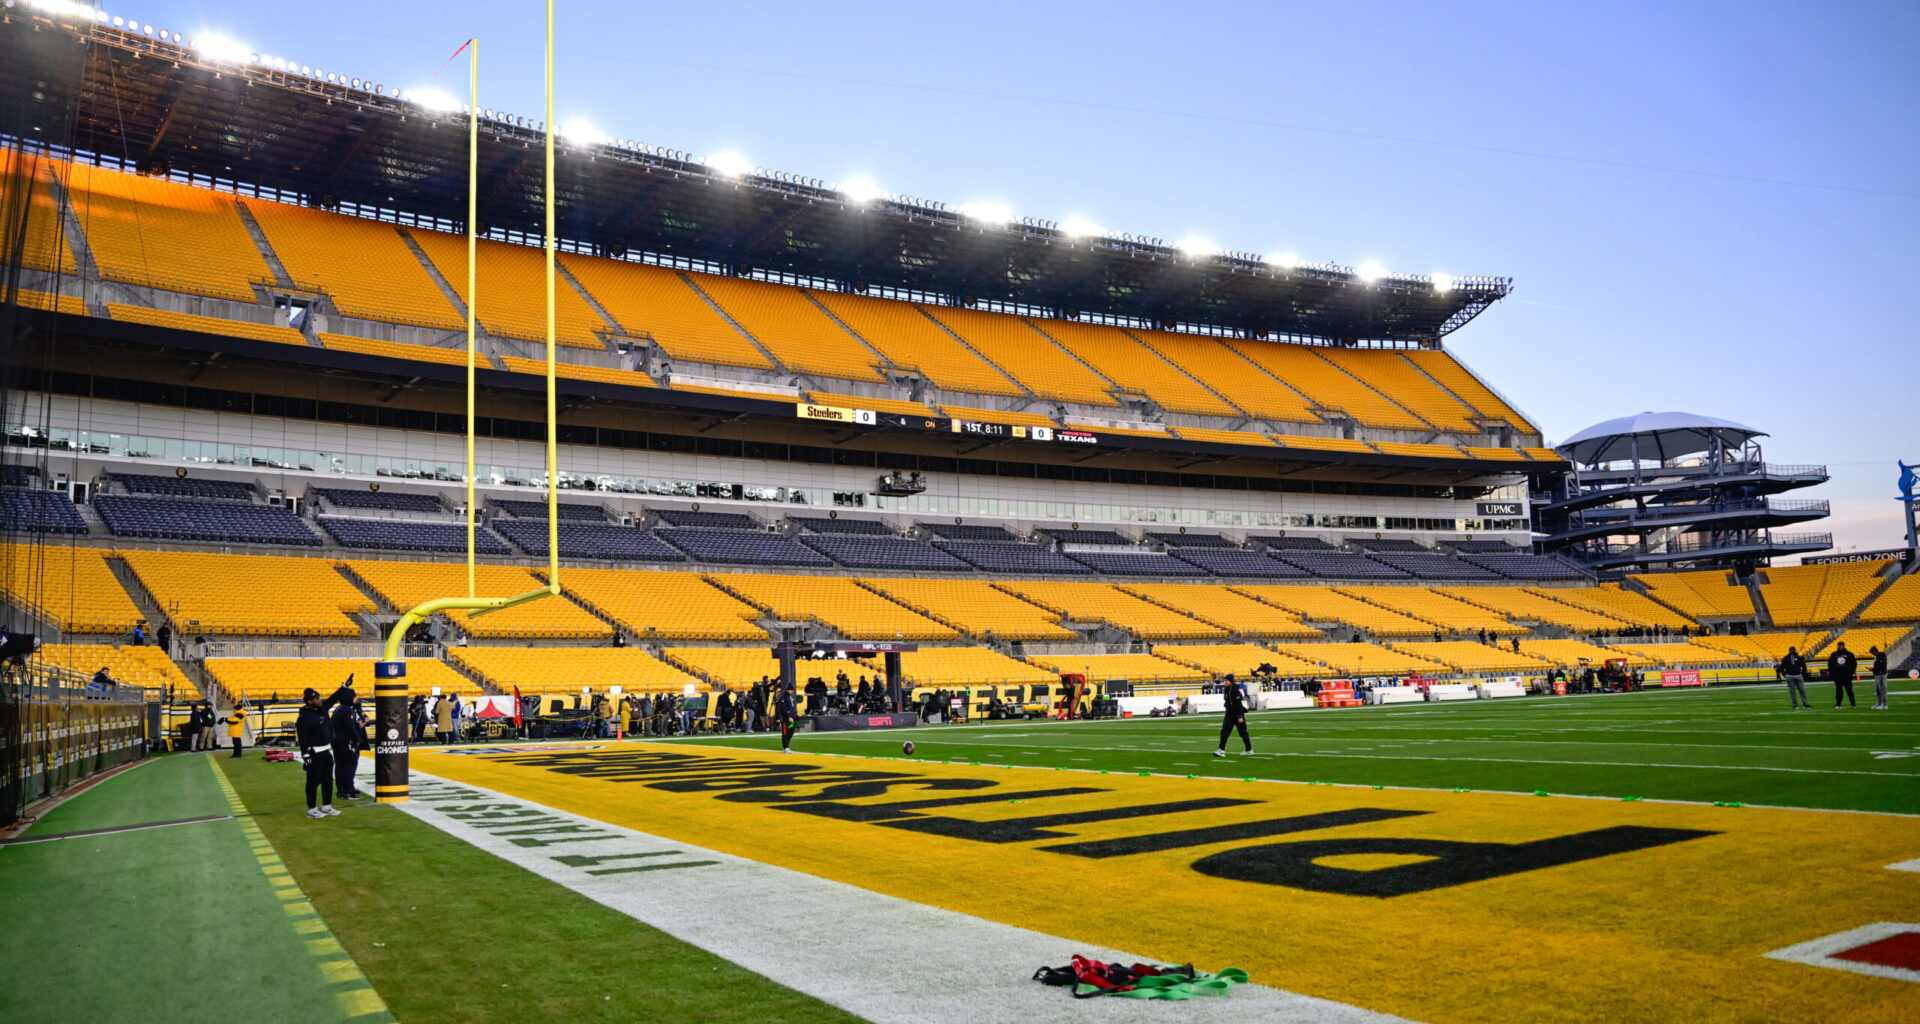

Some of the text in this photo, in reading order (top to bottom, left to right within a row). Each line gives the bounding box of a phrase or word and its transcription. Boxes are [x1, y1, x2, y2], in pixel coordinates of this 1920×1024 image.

[807, 405, 843, 420] Steelers
[862, 412, 869, 422] 0
[925, 420, 936, 429] ON
[966, 423, 982, 432] 1ST
[985, 424, 1003, 434] 8:11
[1038, 430, 1044, 438] 0
[1057, 434, 1098, 444] TEXANS
[1485, 504, 1516, 514] UPMC
[1817, 551, 1907, 566] FORD FAN ZONE
[868, 716, 892, 726] ESPN
[377, 745, 408, 754] CHANGE
